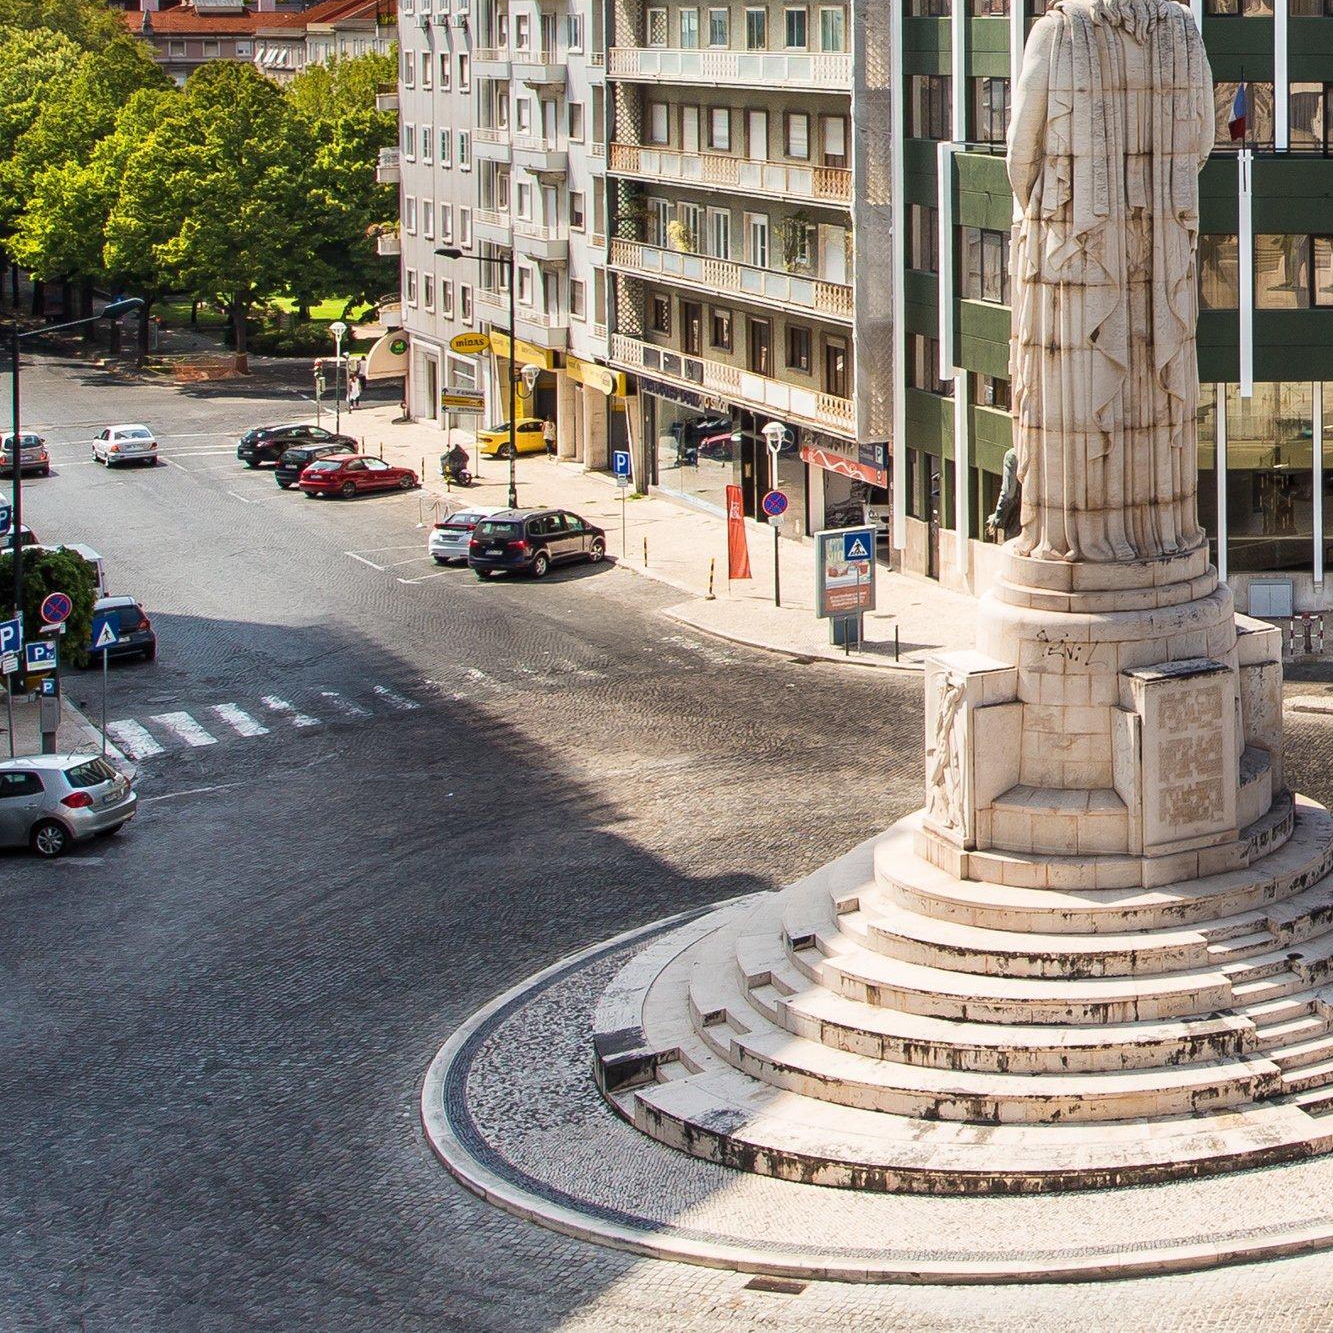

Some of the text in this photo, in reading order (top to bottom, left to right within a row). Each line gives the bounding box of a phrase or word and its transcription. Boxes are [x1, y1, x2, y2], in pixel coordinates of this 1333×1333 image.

[616, 453, 627, 472] P
[0, 625, 14, 652] P
[34, 646, 45, 661] P
[43, 682, 53, 693] P
